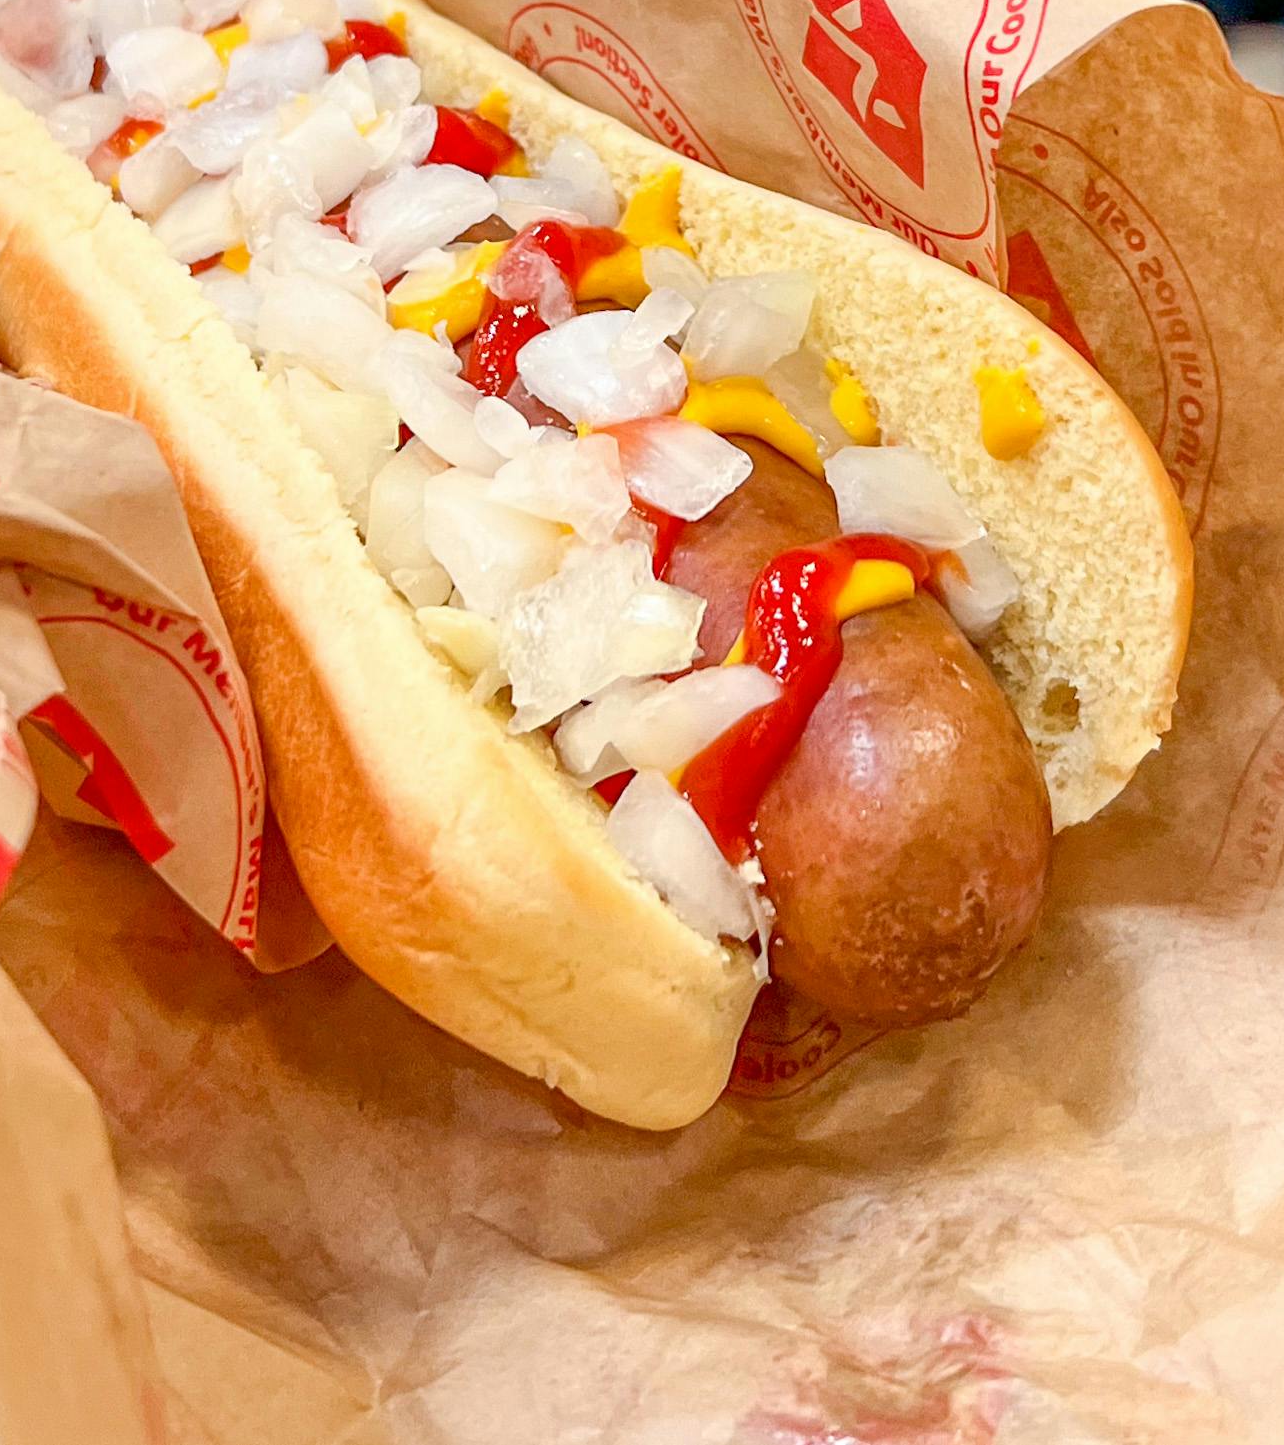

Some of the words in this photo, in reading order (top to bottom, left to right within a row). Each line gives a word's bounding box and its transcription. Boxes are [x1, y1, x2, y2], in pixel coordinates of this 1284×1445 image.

[575, 26, 653, 110] Section!
[980, 60, 1003, 140] Our
[770, 55, 883, 220] Member's
[891, 216, 940, 258] Our
